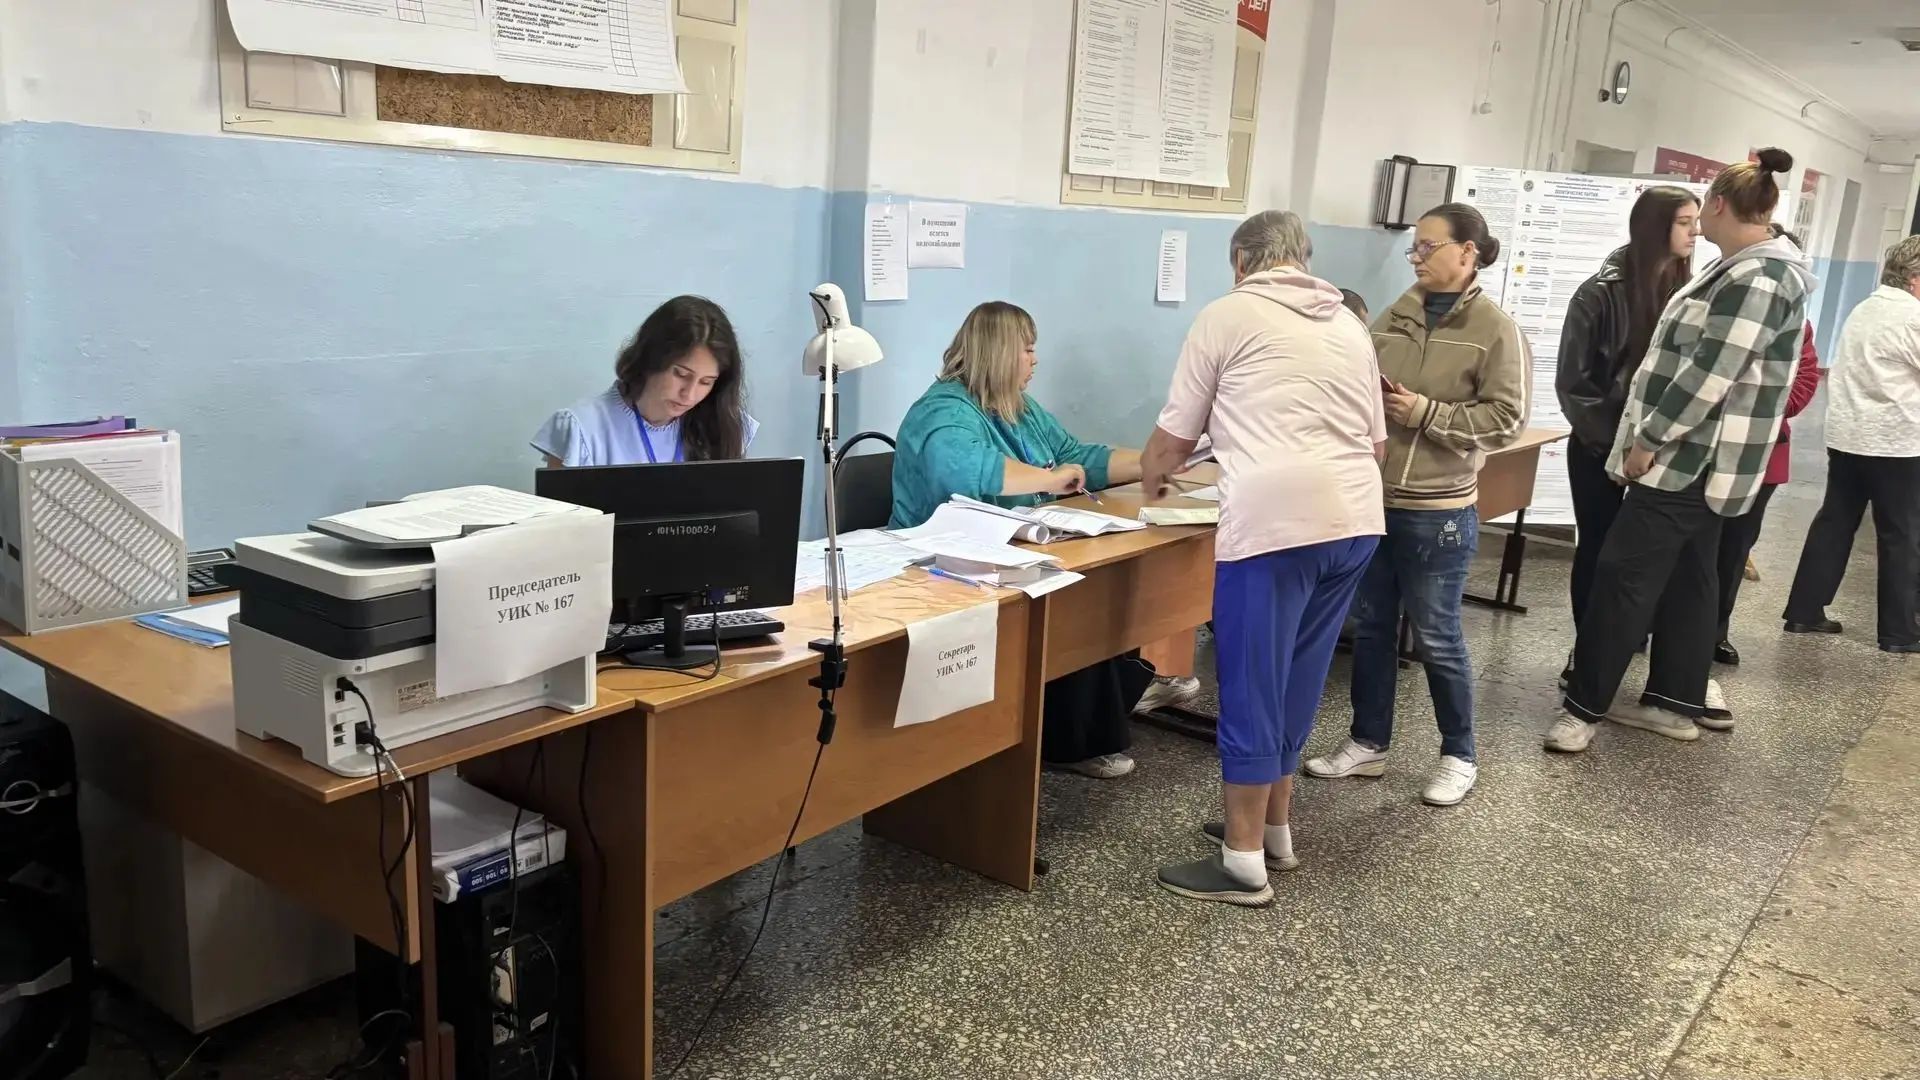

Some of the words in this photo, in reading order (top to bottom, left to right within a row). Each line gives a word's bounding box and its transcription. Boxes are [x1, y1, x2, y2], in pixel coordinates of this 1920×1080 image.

[488, 572, 581, 601] Председатель
[497, 603, 532, 624] УИК
[535, 600, 550, 615] №
[554, 594, 575, 611] 167
[938, 643, 976, 661] Секретарь
[936, 663, 955, 679] УИК
[955, 661, 964, 672] №
[966, 656, 978, 668] 167
